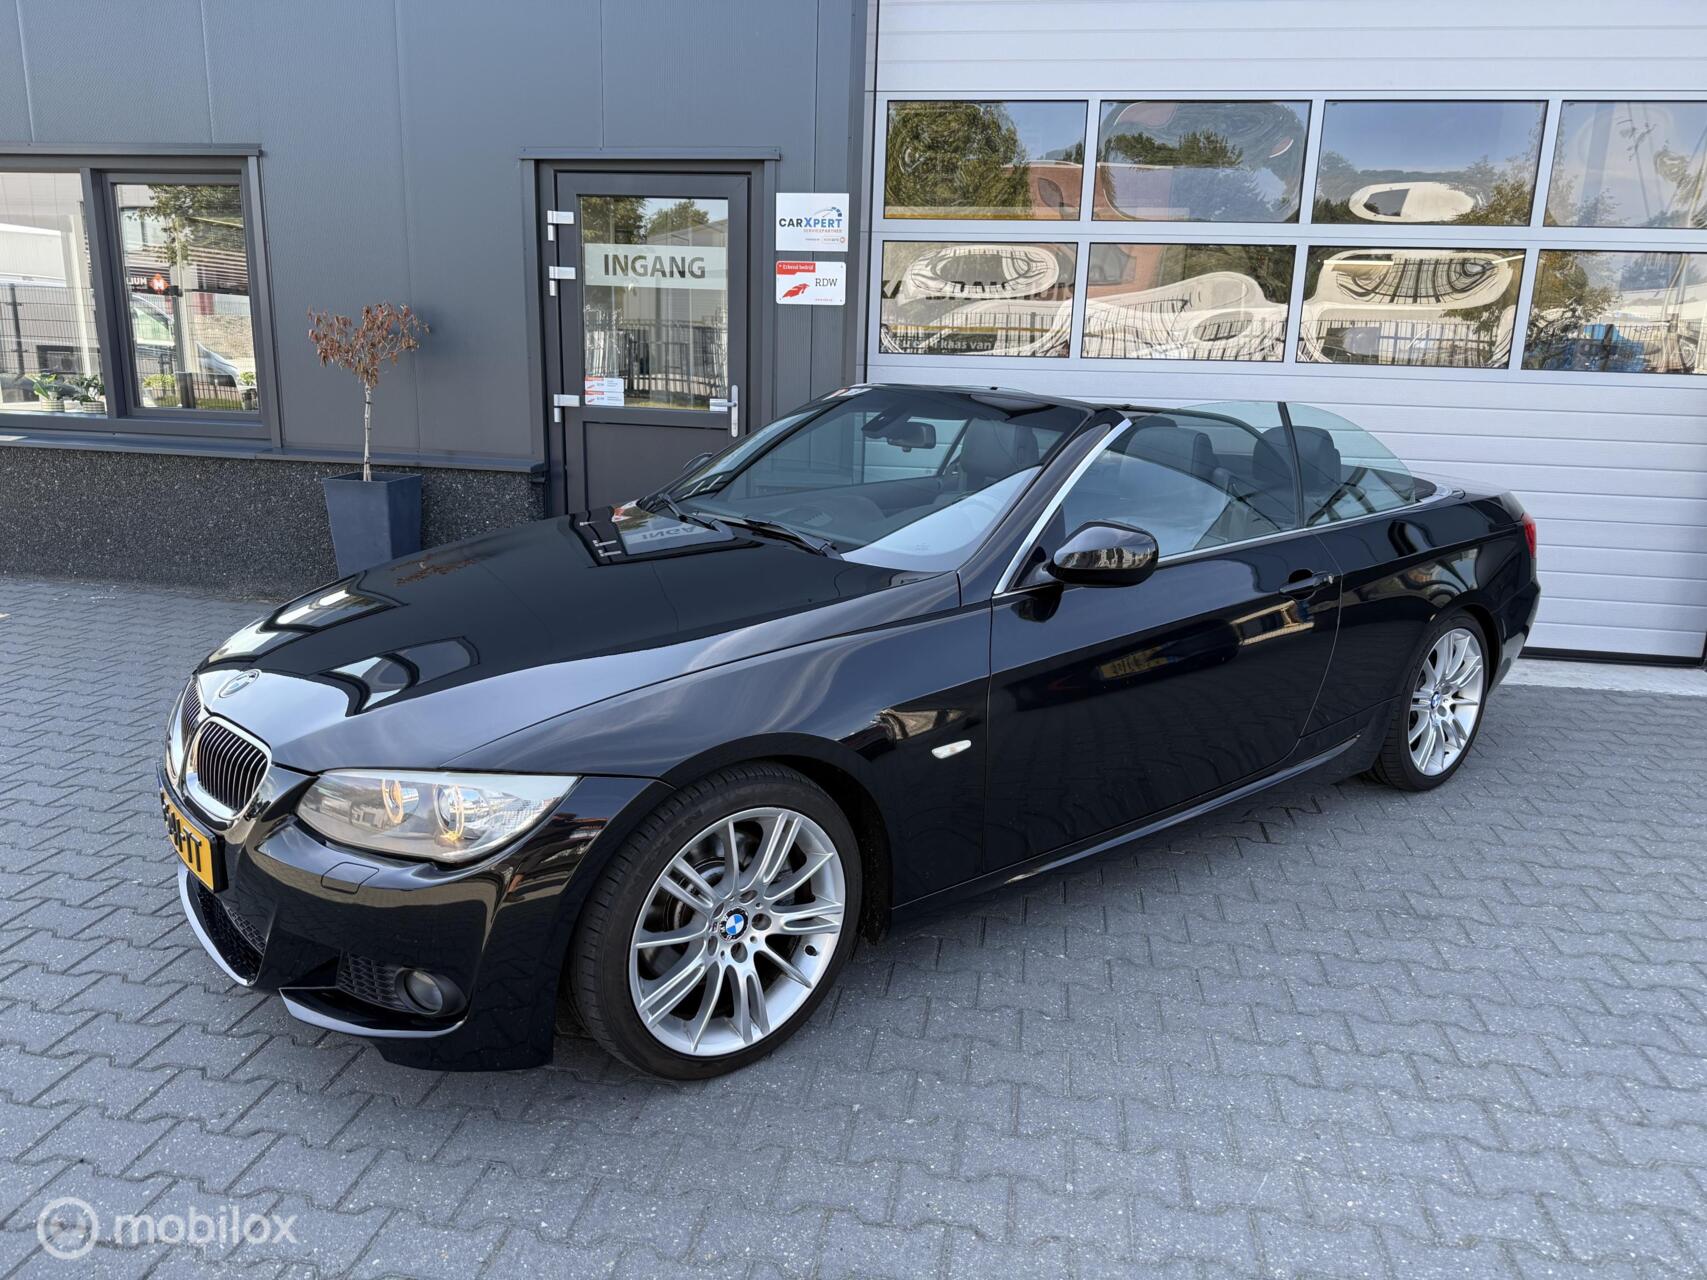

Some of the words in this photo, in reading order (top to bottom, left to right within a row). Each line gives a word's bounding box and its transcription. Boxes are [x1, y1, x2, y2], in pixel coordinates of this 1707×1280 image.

[778, 217, 843, 228] CARXPERT
[603, 254, 706, 279] INGANG
[815, 277, 838, 287] RDW
[940, 338, 967, 349] kaas
[969, 341, 992, 350] van
